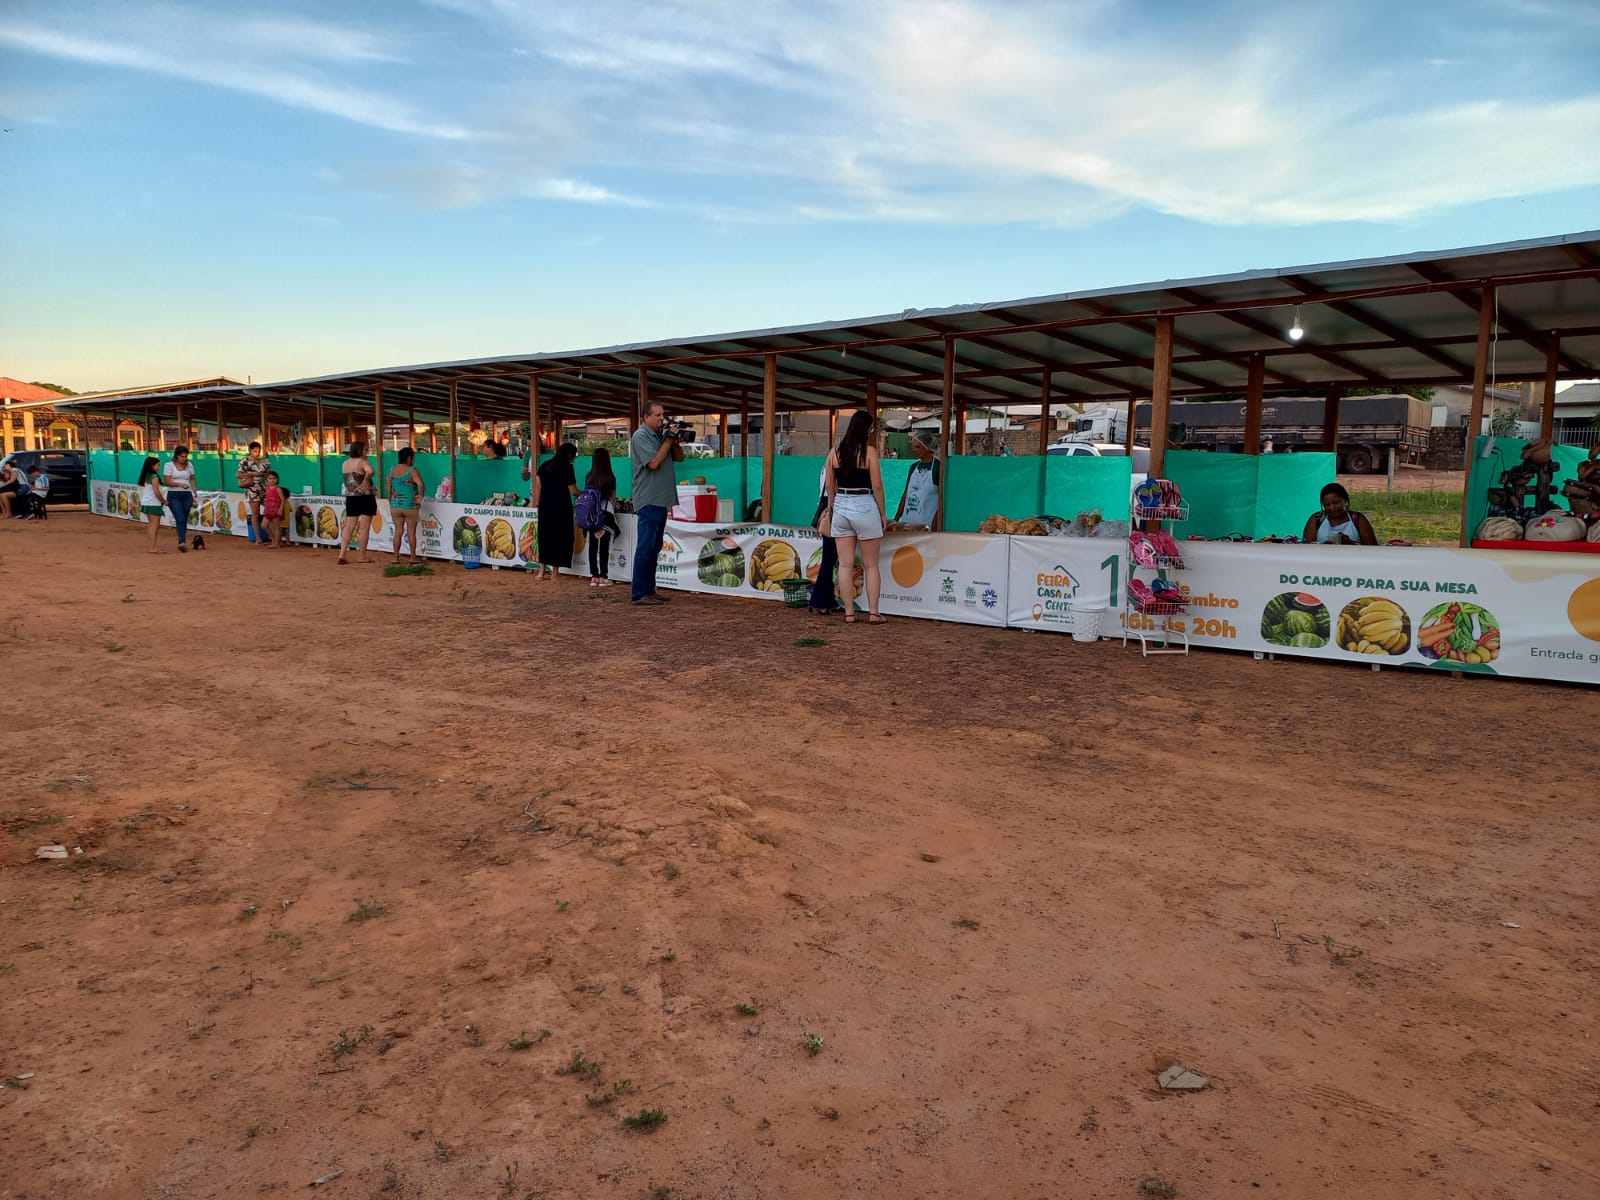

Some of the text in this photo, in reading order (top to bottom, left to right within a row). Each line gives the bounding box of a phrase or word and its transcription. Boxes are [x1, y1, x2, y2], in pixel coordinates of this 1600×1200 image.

[473, 508, 493, 516] CAMPO
[495, 509, 510, 517] PARA
[512, 510, 524, 518] SUA
[715, 528, 819, 540] DO CAMPO PARA SUA
[1037, 573, 1070, 587] FEIRA
[1279, 574, 1478, 595] DO CAMPO PARA SUA MESA
[880, 592, 898, 601] ntrada
[1037, 587, 1063, 599] CASA
[1119, 611, 1155, 631] 16h
[1192, 618, 1237, 638] 20h
[1530, 647, 1583, 661] Entrada
